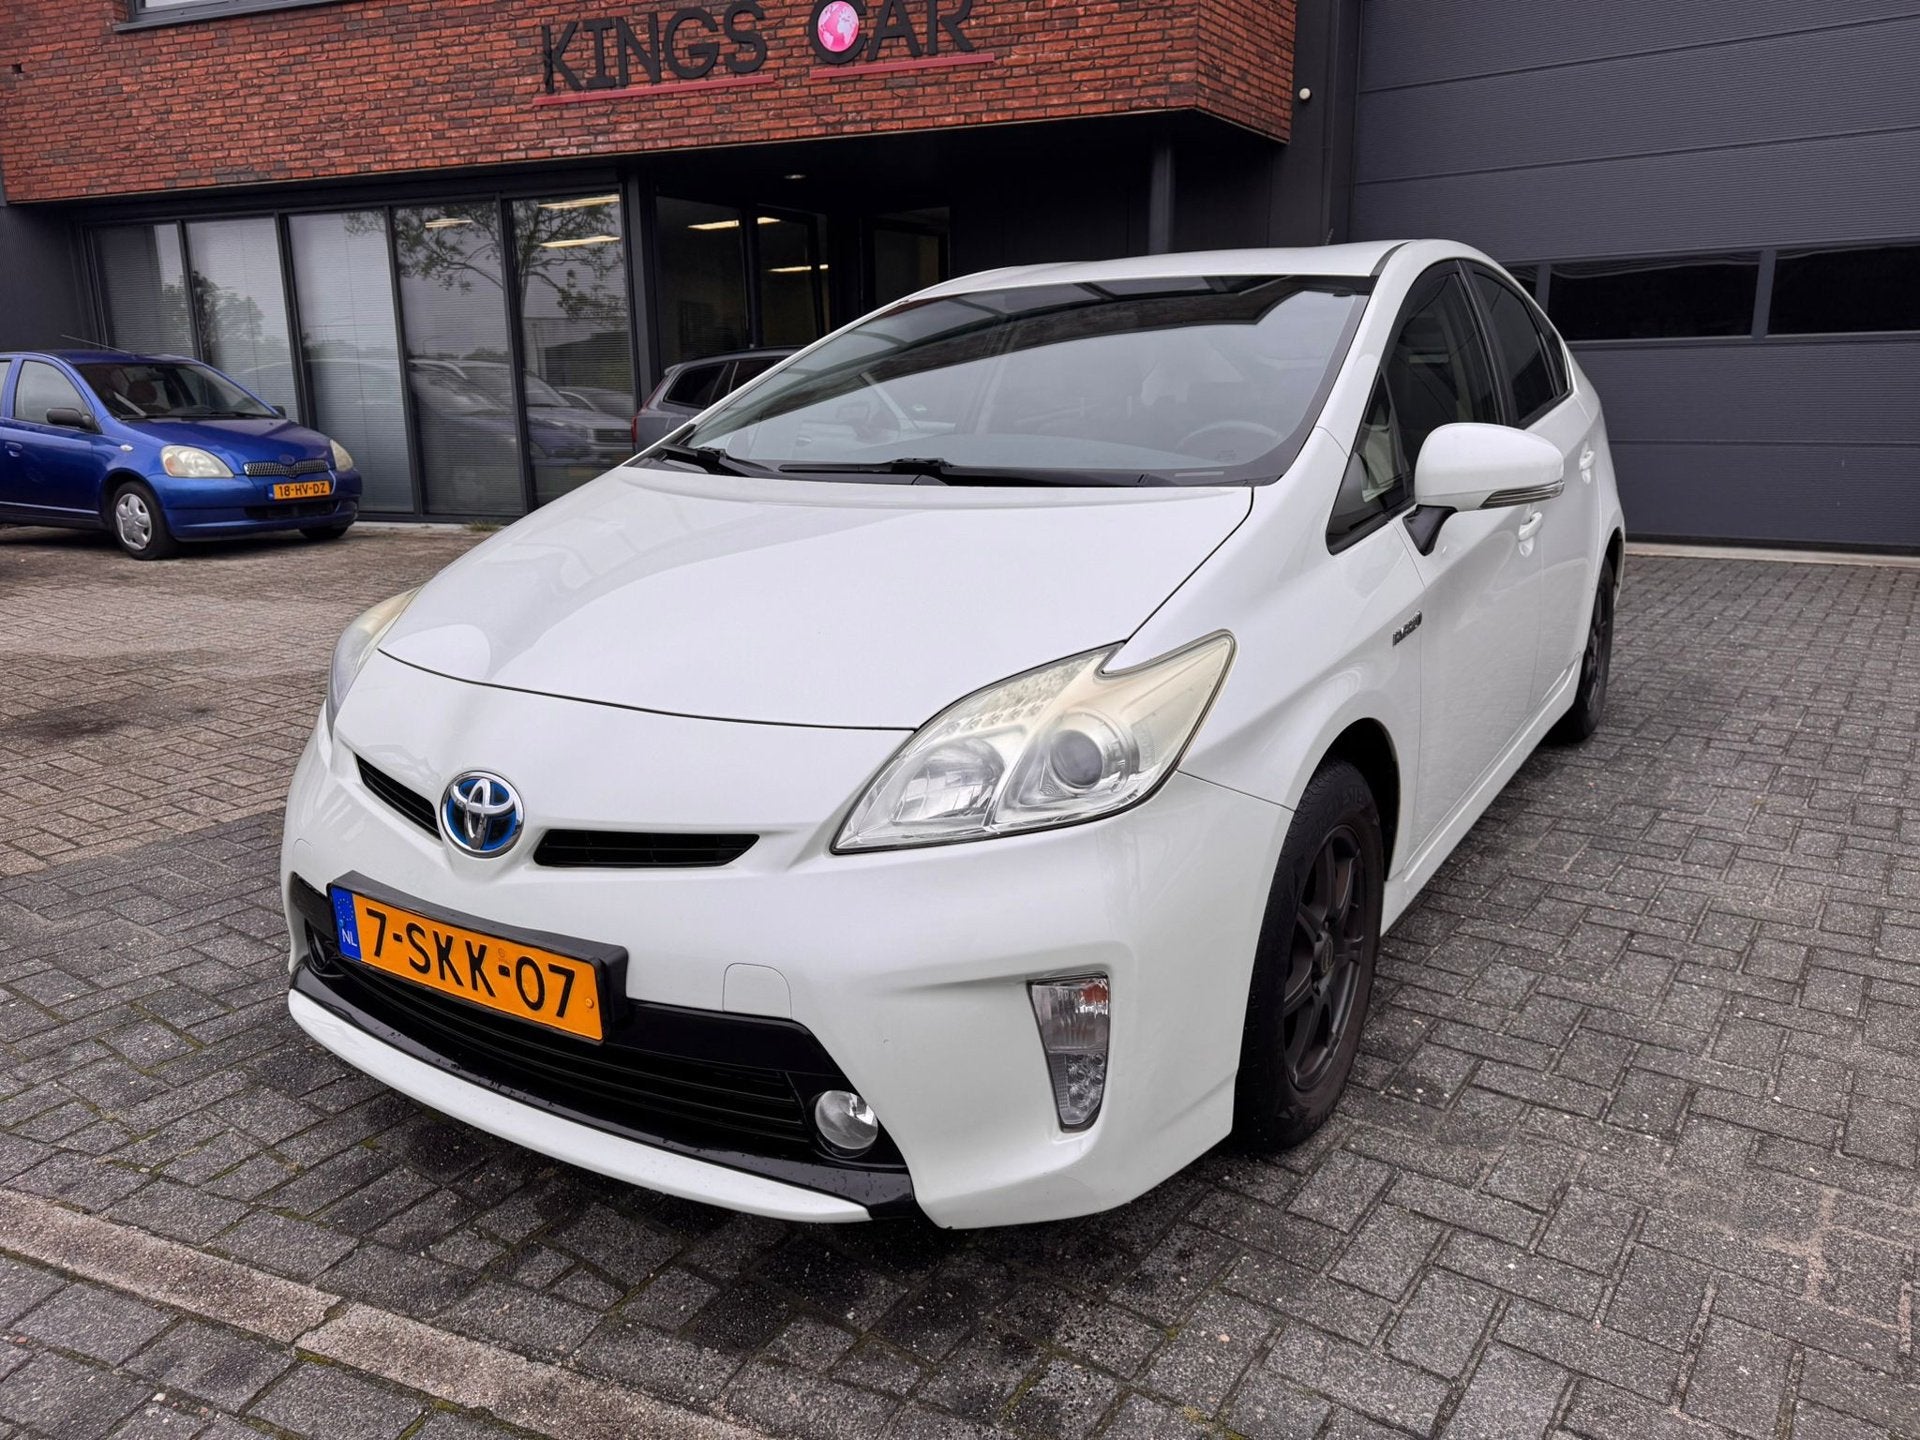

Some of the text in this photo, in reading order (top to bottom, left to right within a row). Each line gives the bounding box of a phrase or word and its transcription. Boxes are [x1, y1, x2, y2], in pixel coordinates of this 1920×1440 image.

[541, 0, 976, 93] KINGS CAR
[279, 482, 326, 497] 18-HV-DZ
[342, 928, 358, 947] NL
[366, 906, 575, 1018] 7-SKK-07
